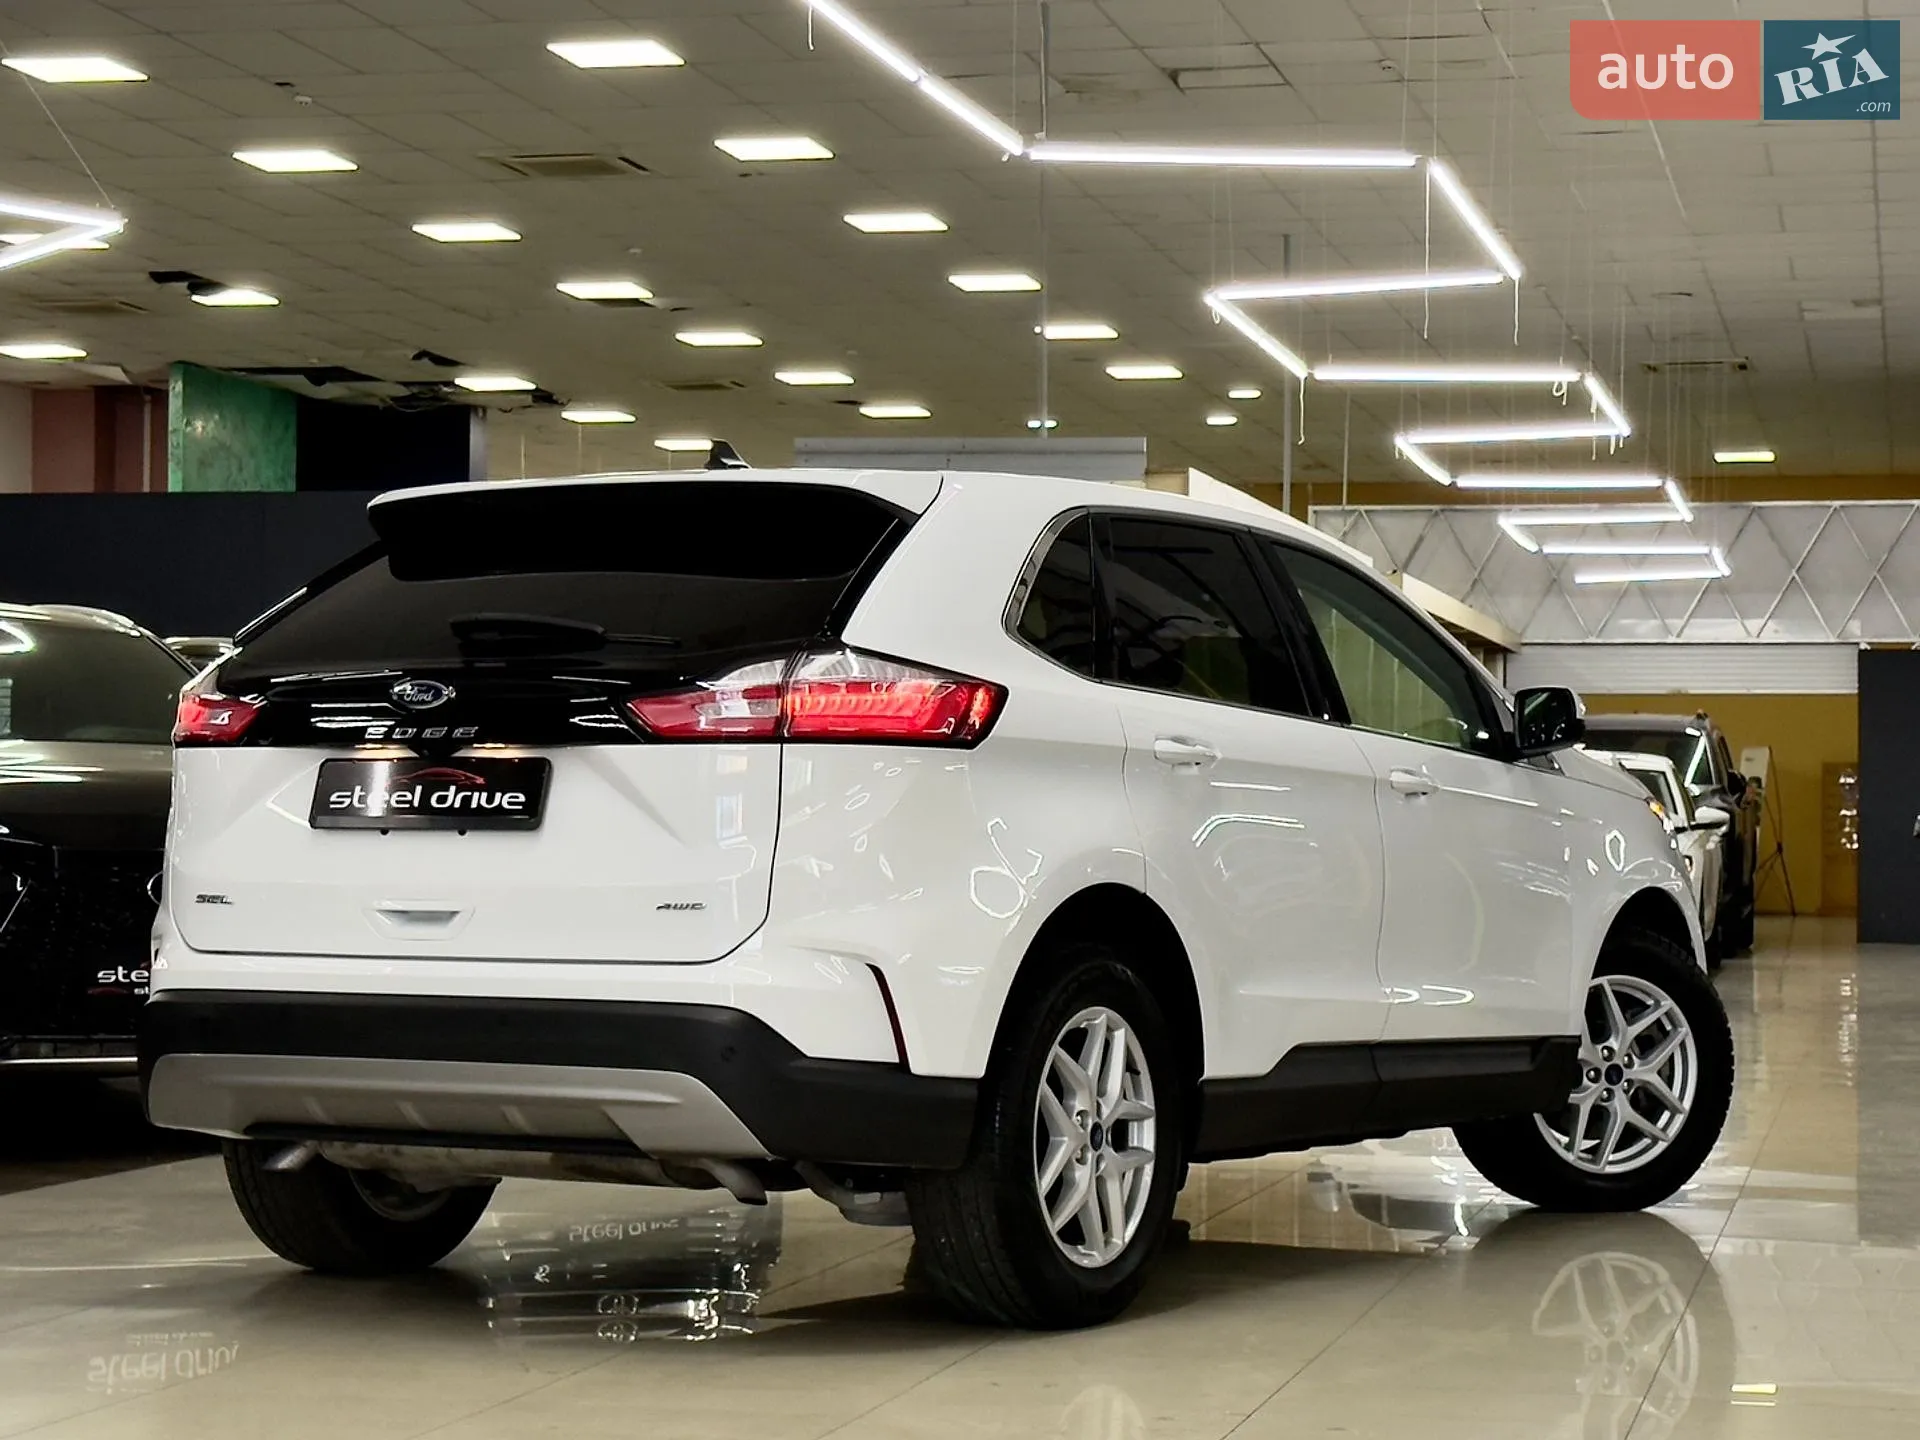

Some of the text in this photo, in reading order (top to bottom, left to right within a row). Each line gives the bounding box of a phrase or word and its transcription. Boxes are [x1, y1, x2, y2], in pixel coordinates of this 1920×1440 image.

[402, 685, 435, 702] Ford
[364, 726, 479, 739] EDGE
[329, 784, 527, 811] steel drive
